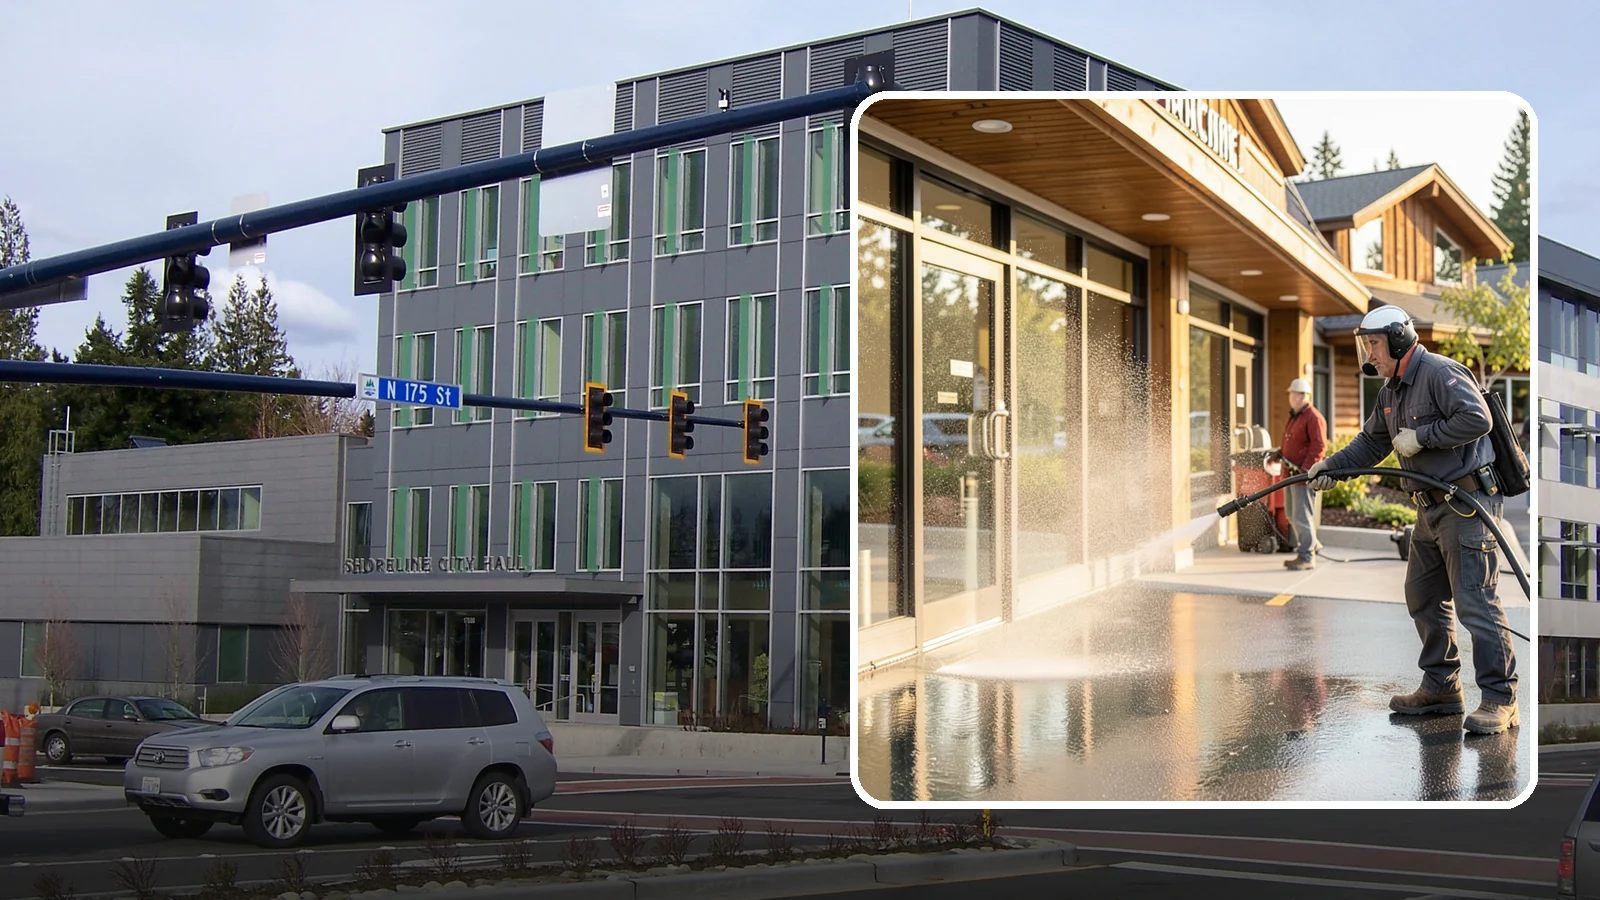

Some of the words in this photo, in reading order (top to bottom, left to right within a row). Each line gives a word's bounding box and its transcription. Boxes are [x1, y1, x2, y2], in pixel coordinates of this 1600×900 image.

[387, 380, 396, 400] N
[405, 382, 427, 403] 175
[436, 386, 451, 406] St
[344, 556, 432, 574] SHORELINE
[438, 556, 477, 573] CITY
[484, 555, 526, 573] HALL
